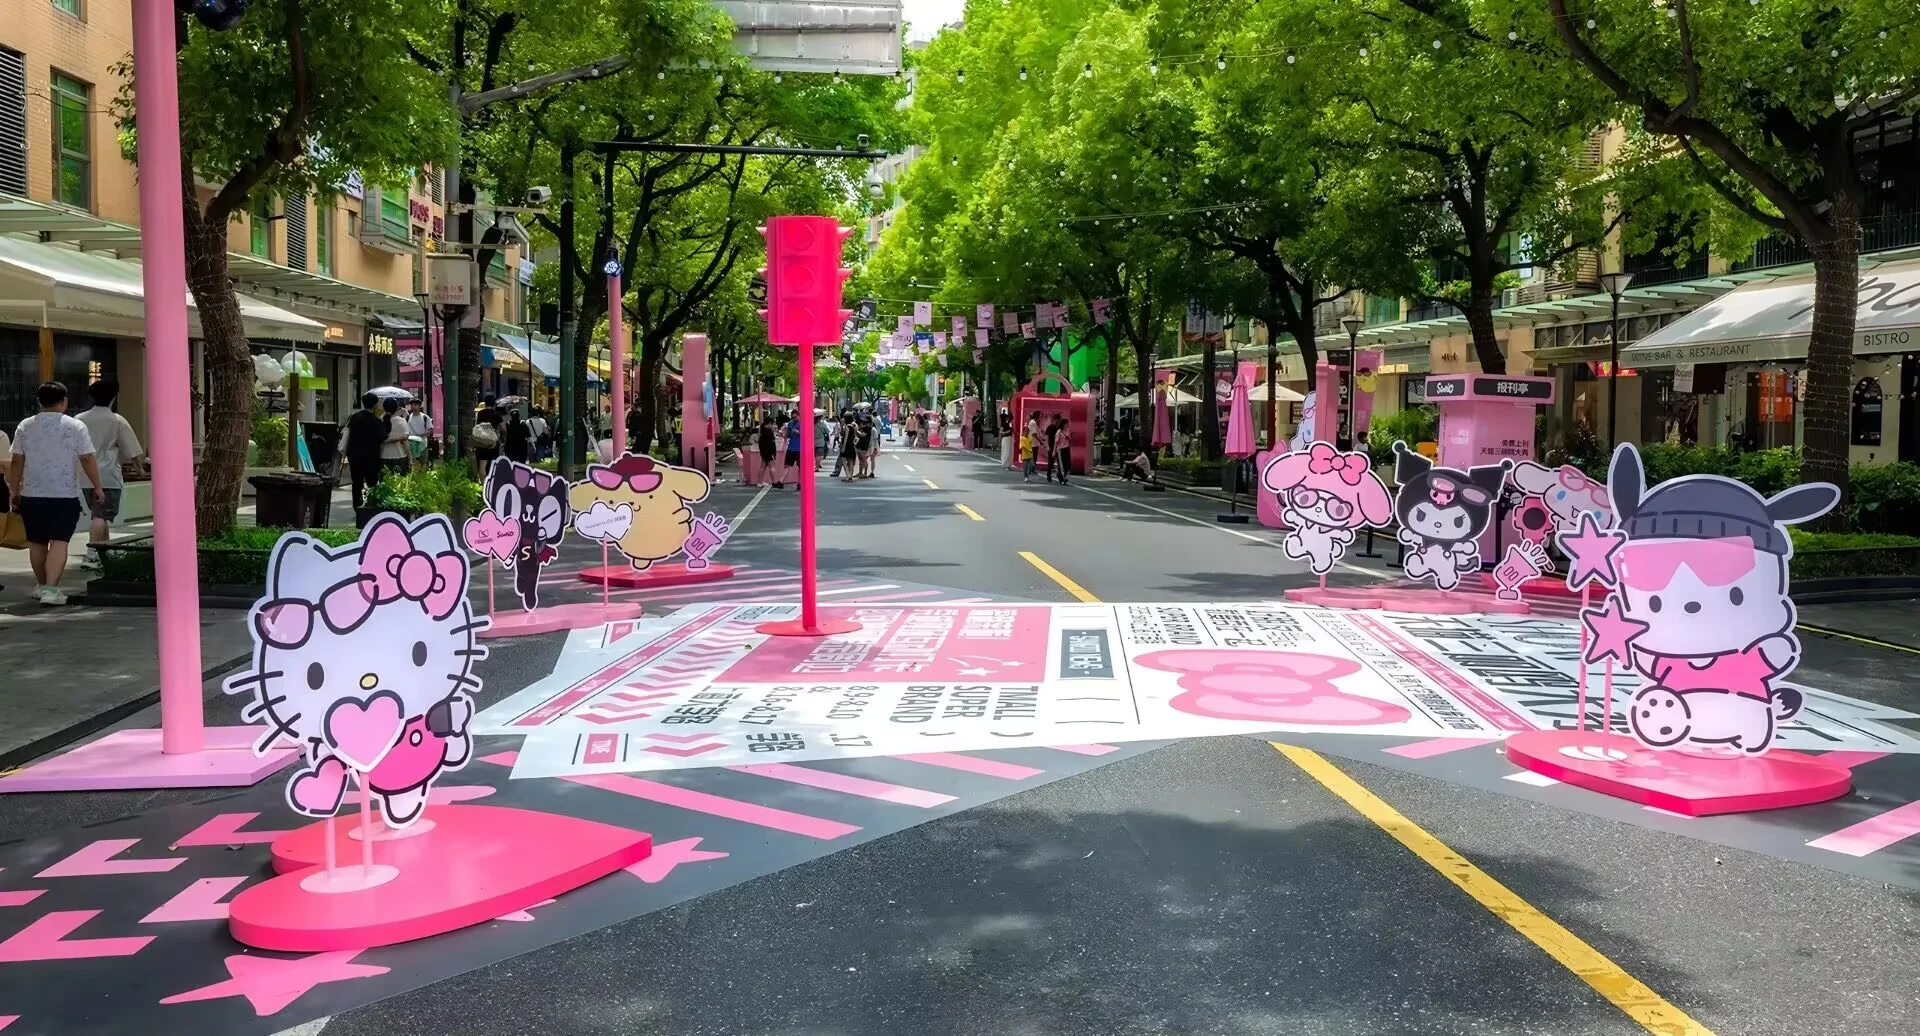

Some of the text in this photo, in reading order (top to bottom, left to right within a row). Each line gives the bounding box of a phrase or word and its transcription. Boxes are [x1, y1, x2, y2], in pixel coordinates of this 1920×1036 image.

[1863, 332, 1910, 346] BISTRO
[1631, 344, 1750, 362] WINE BAR & RESTAURANT
[1496, 381, 1529, 394] 报刊亭
[888, 685, 945, 723] BRAND
[941, 685, 991, 718] SUPER
[992, 685, 1038, 720] TMALL
